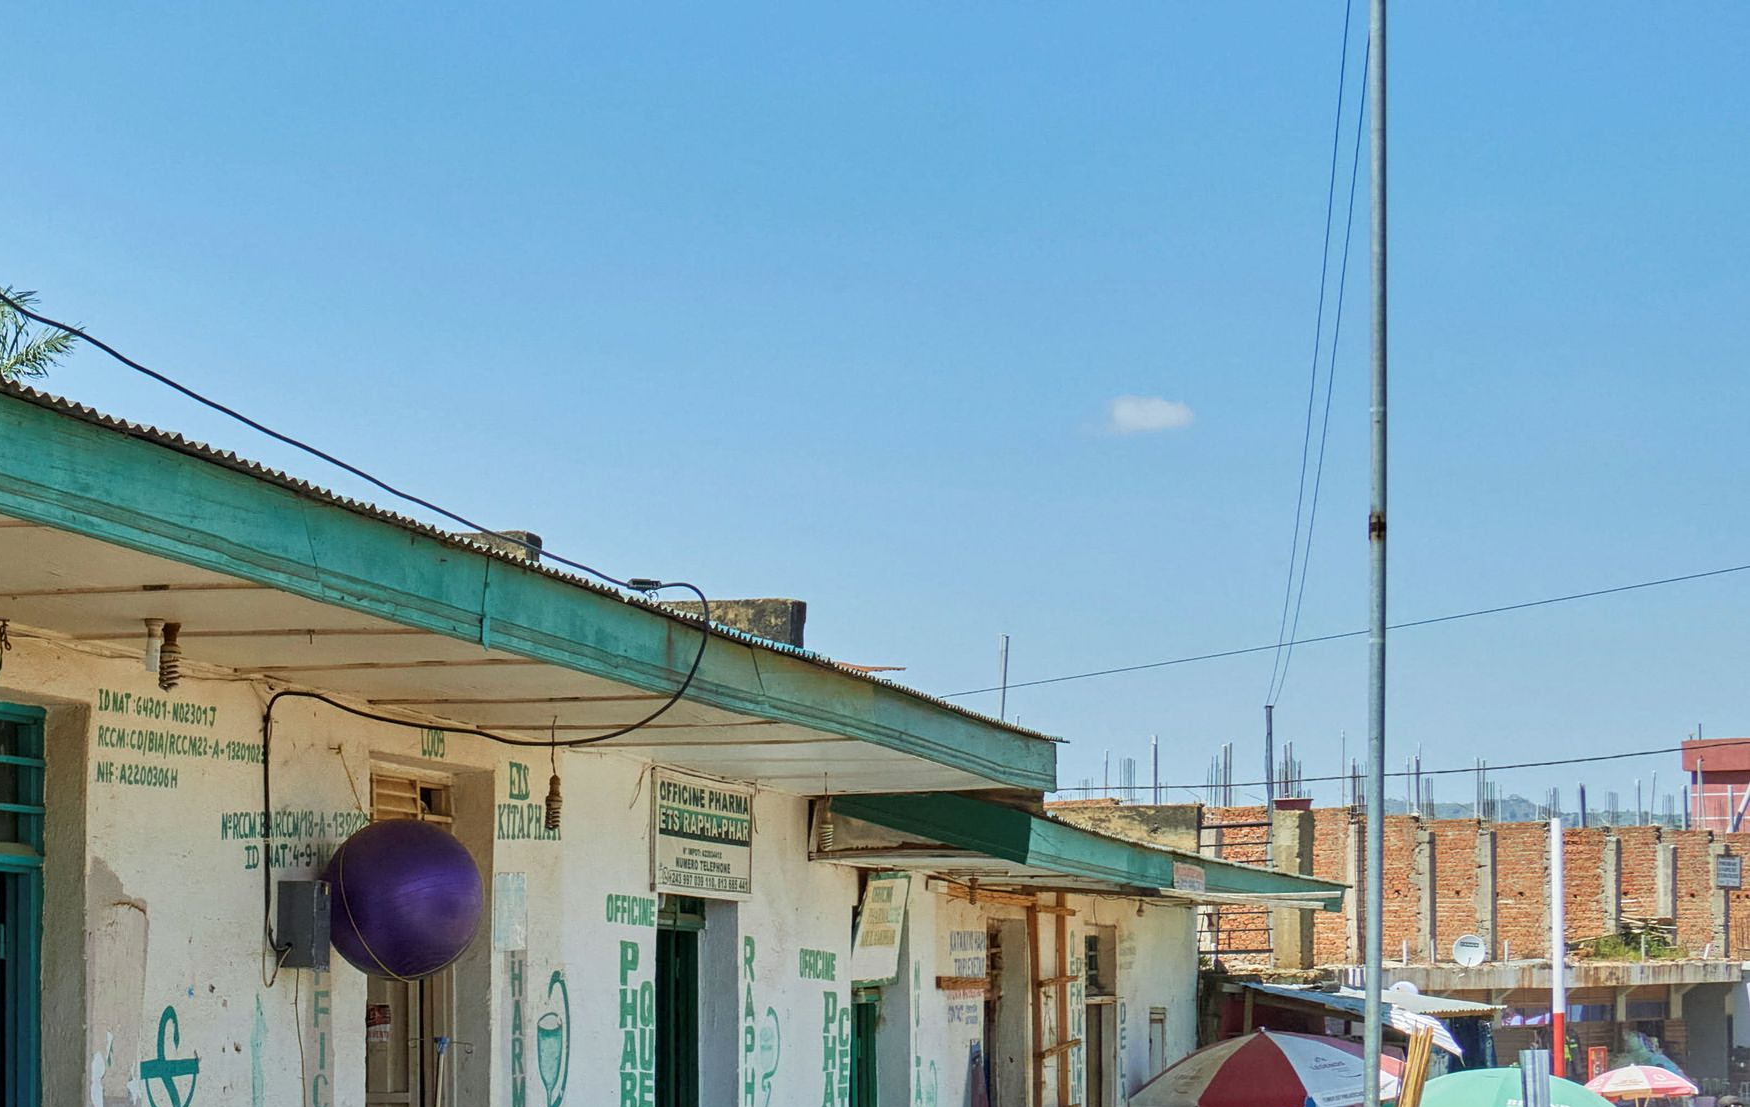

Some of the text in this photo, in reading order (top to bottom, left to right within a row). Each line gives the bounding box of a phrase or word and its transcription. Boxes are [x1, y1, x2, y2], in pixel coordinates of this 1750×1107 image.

[660, 780, 749, 816] OFFICINE PHARMA
[660, 807, 749, 841] ETS RAPHA-PHAR
[606, 893, 656, 928] OFFICINE
[799, 948, 836, 982] OFFICINE
